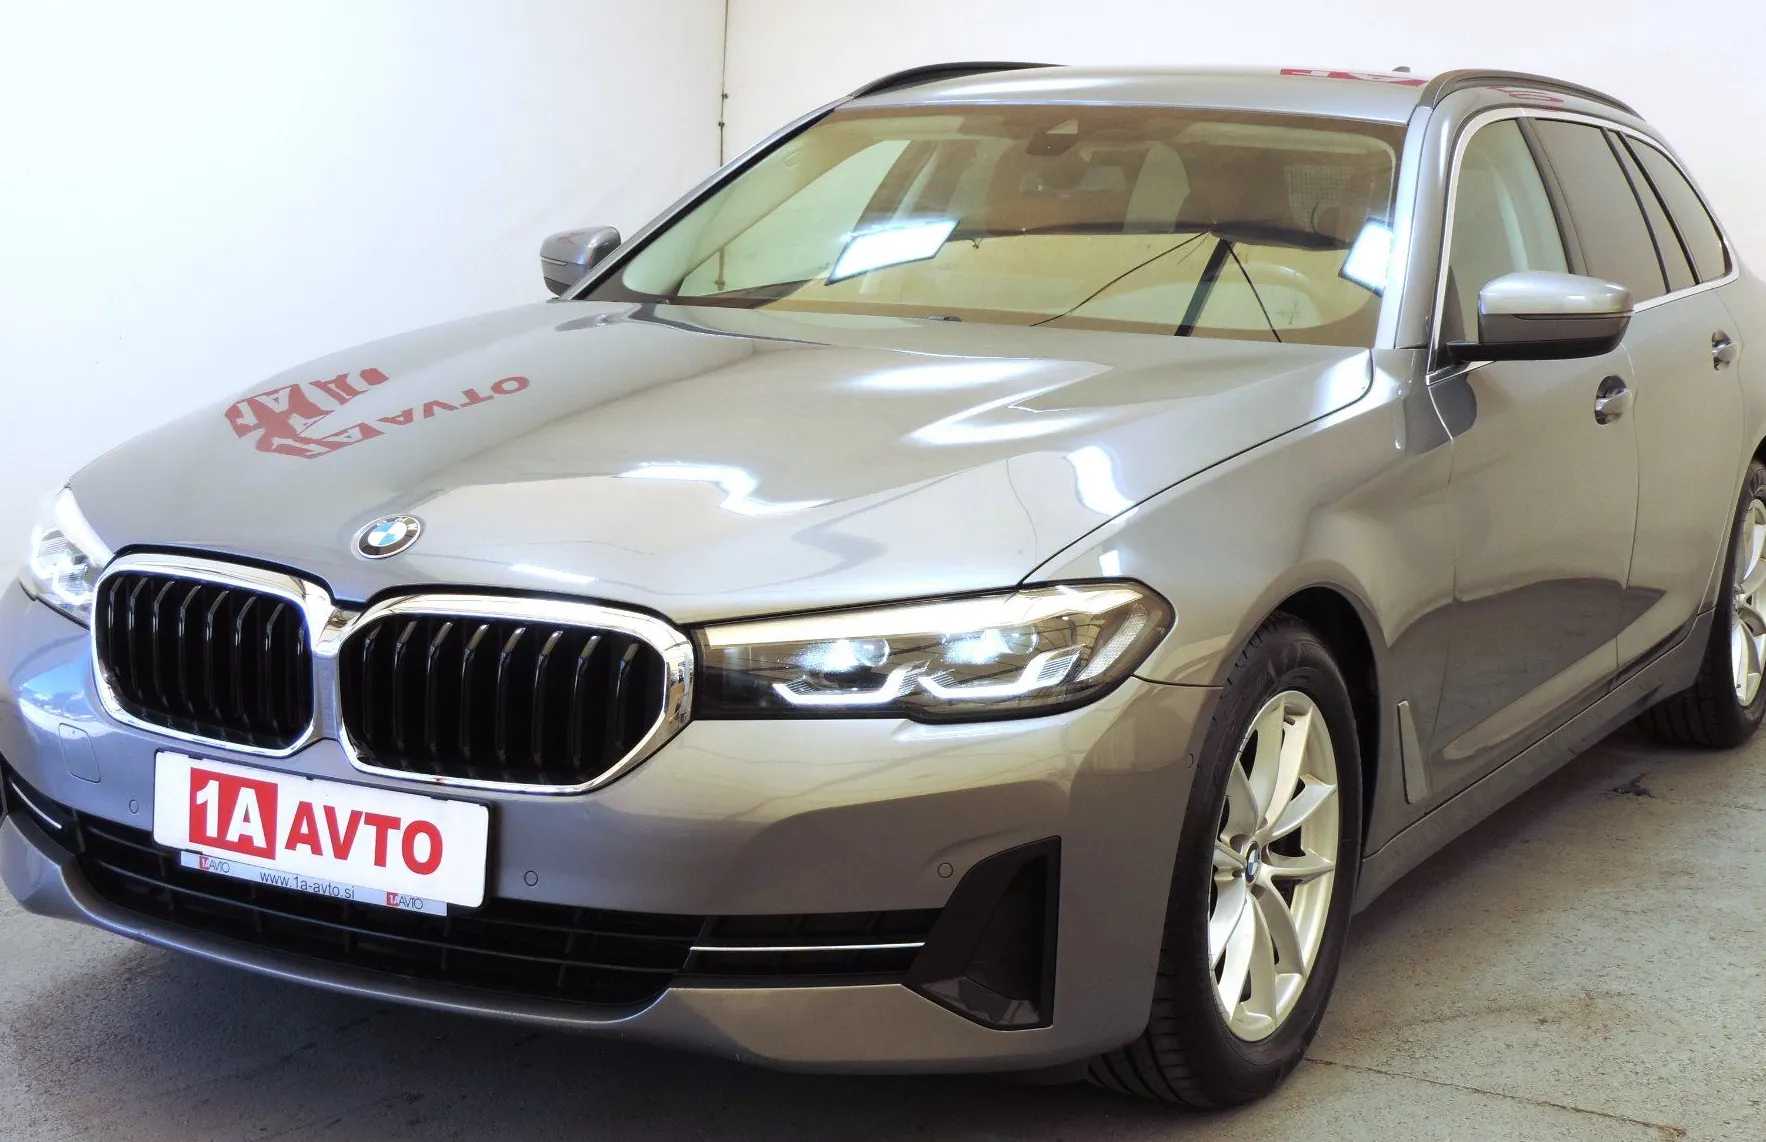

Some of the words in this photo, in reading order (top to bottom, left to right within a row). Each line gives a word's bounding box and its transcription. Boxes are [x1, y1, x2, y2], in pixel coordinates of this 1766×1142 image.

[195, 778, 269, 850] 1A
[285, 801, 443, 875] AVTO
[260, 871, 355, 899] www.1a-avto.si
